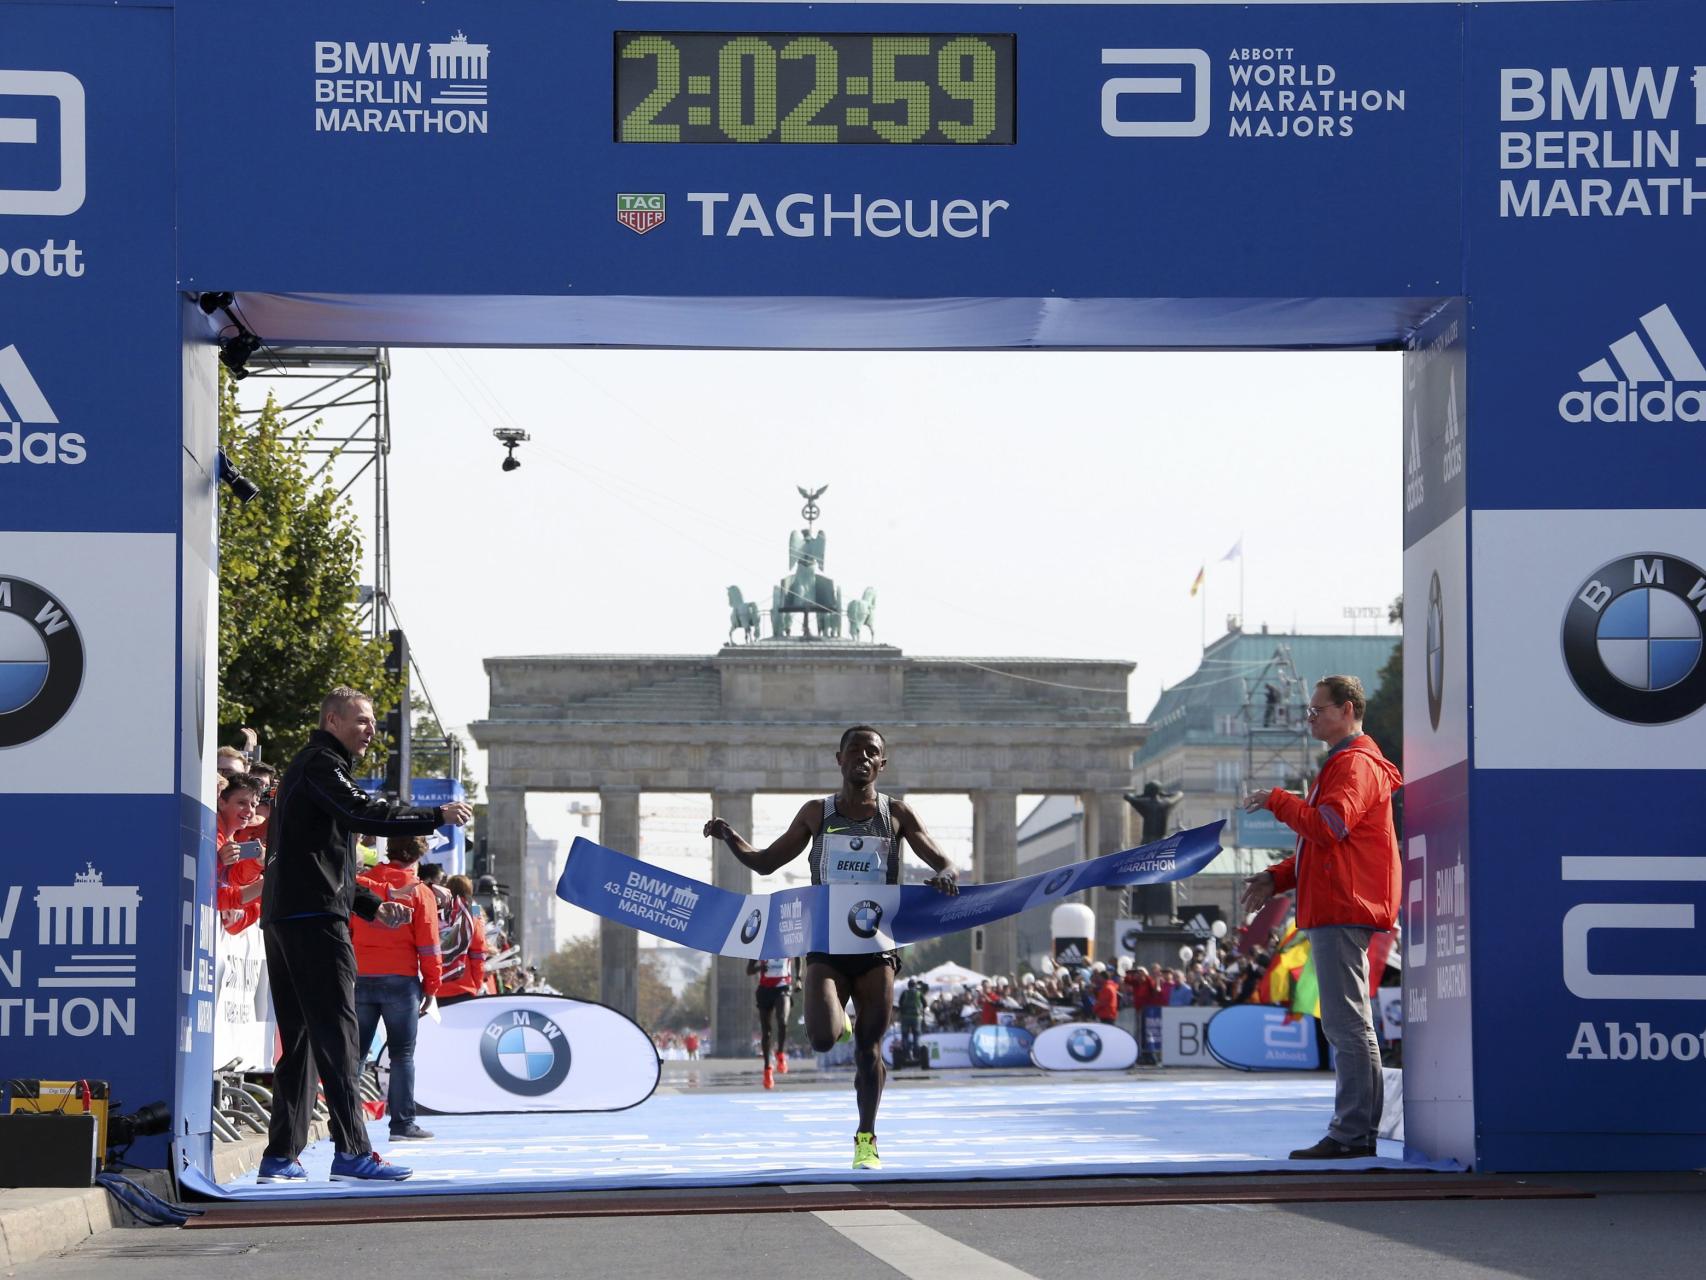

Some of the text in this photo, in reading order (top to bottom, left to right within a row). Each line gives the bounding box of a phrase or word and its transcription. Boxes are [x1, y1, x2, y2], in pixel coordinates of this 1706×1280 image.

[315, 42, 420, 74] BMW
[1229, 48, 1294, 60] ABBOTT
[1229, 65, 1336, 86] WORLD
[315, 81, 421, 103] BERLIN
[622, 36, 996, 143] 2:02:59
[1229, 90, 1406, 111] MARATHON
[1501, 66, 1680, 121] BMW
[315, 108, 488, 133] MARATHON
[1229, 116, 1353, 137] MAJORS
[1500, 130, 1680, 169] BERLIN
[621, 197, 661, 209] TAG
[620, 212, 663, 231] HEUER
[837, 860, 870, 873] BEKELE
[1117, 859, 1176, 873] MARATHON
[627, 871, 673, 898] BMW
[1436, 868, 1453, 916] BMW
[622, 887, 667, 911] BERLIN
[618, 899, 688, 932] MARATHON
[486, 1011, 561, 1040] BMW
[1566, 1022, 1706, 1061] Abbo
[1265, 1050, 1308, 1062] Abbott
